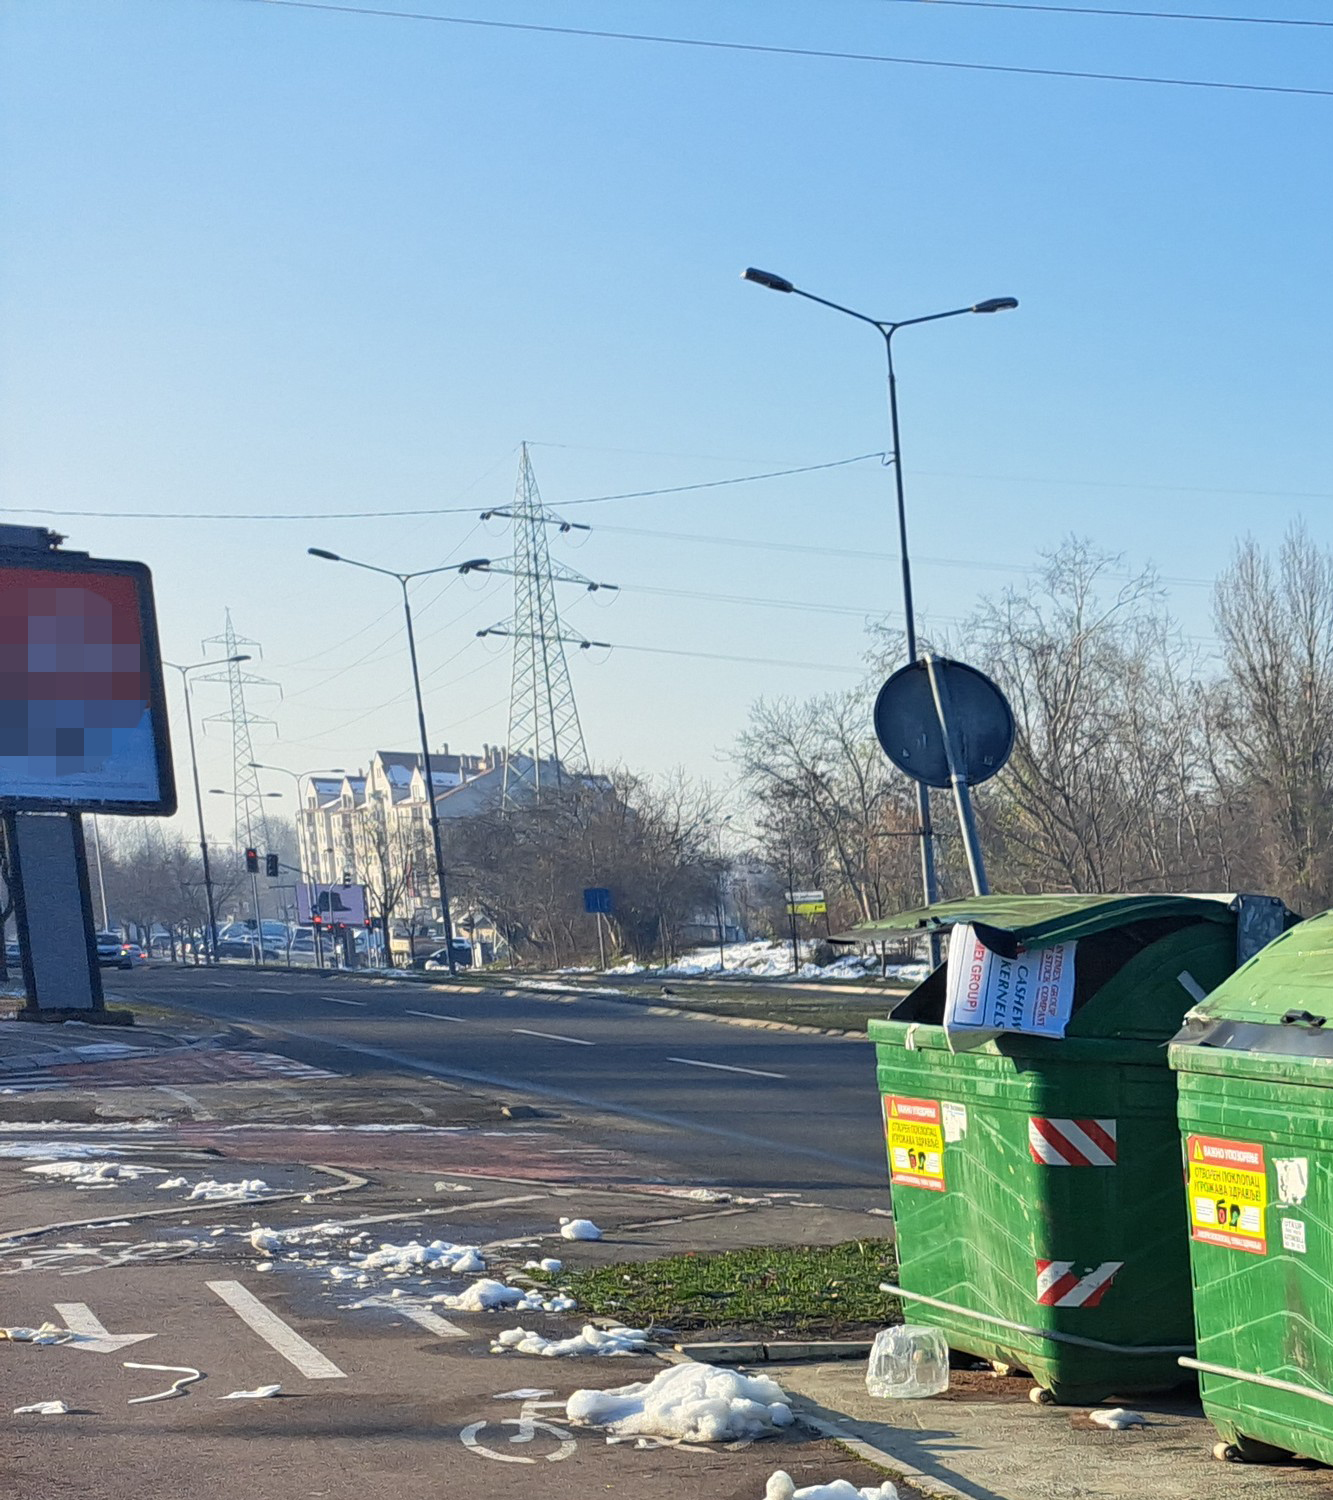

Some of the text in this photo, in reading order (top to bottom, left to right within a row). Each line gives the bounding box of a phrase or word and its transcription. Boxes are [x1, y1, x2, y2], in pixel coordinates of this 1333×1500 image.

[993, 960, 1013, 1029] KERNELS
[1011, 965, 1029, 1031] CASHEW
[1194, 1167, 1259, 1188] ОТВОРЕН ПОКЛОПАЦ
